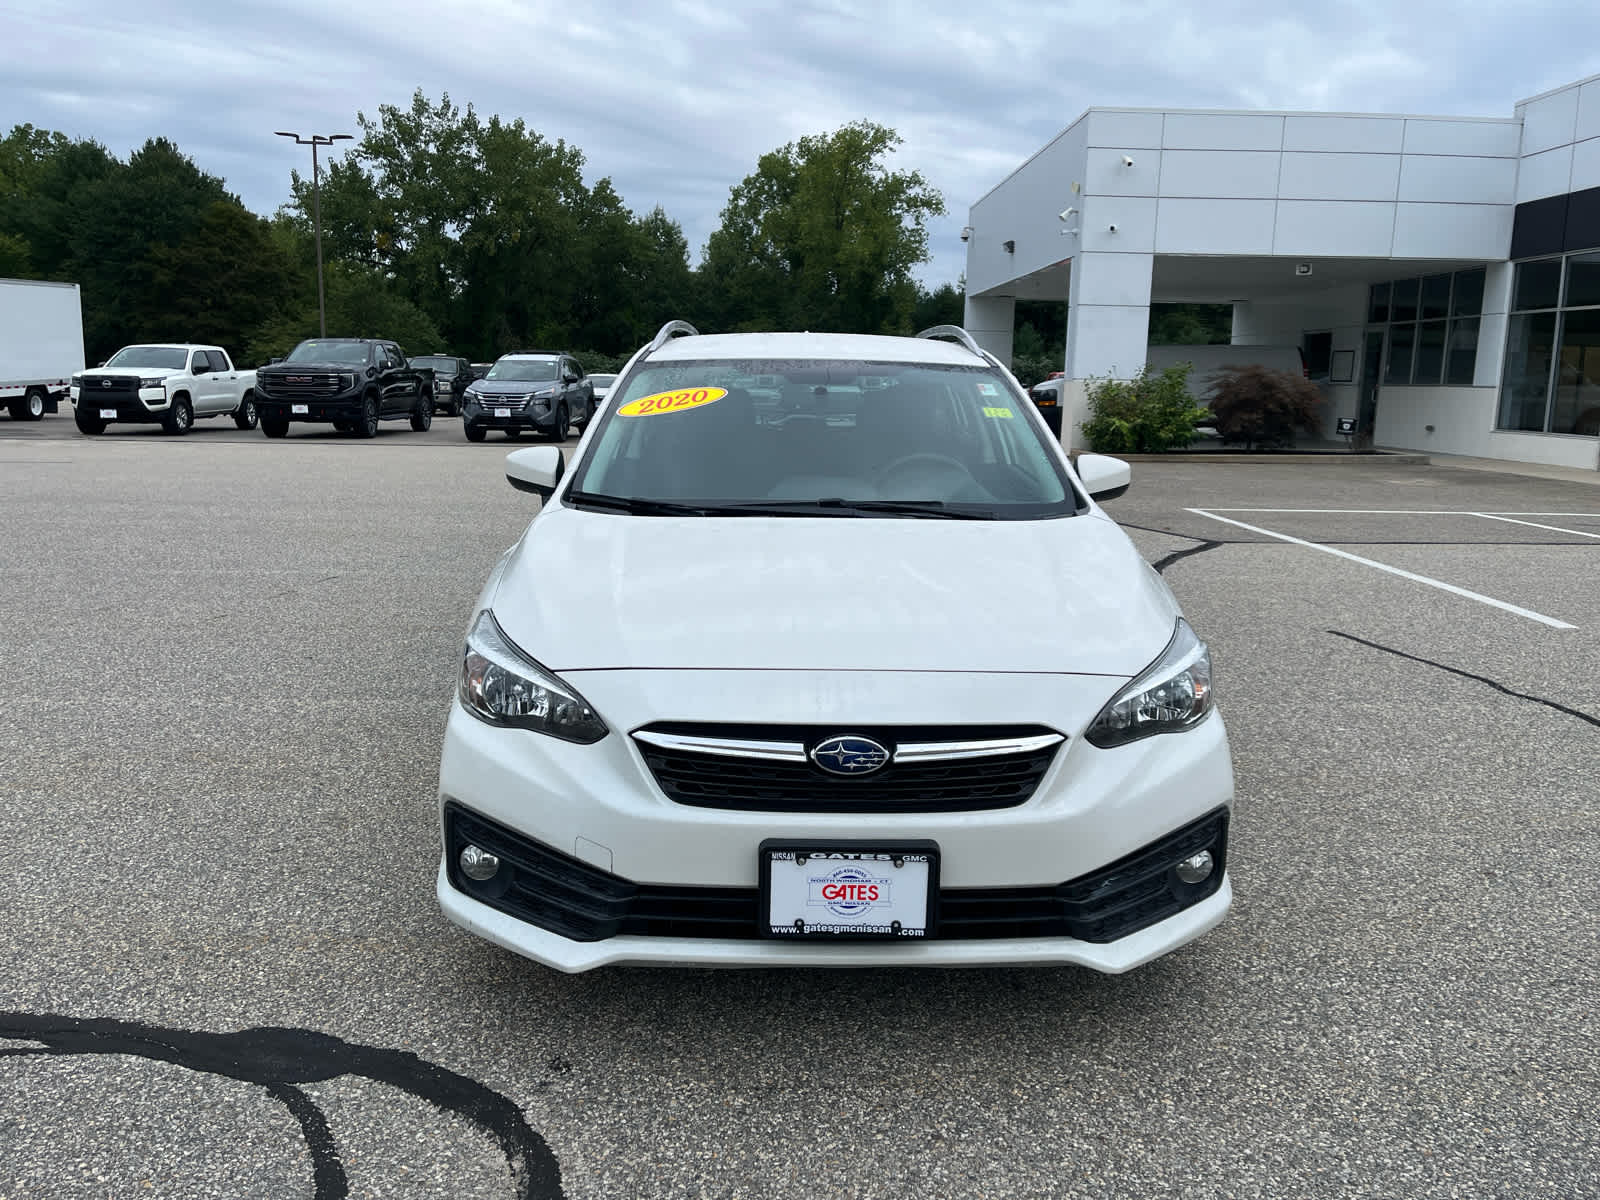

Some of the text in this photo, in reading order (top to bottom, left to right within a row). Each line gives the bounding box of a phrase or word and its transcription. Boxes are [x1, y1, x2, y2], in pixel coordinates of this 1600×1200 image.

[638, 390, 708, 415] 2020
[809, 853, 891, 861] GATES
[822, 884, 879, 901] GATES
[771, 923, 924, 937] www. gatesgmcnissan .com
